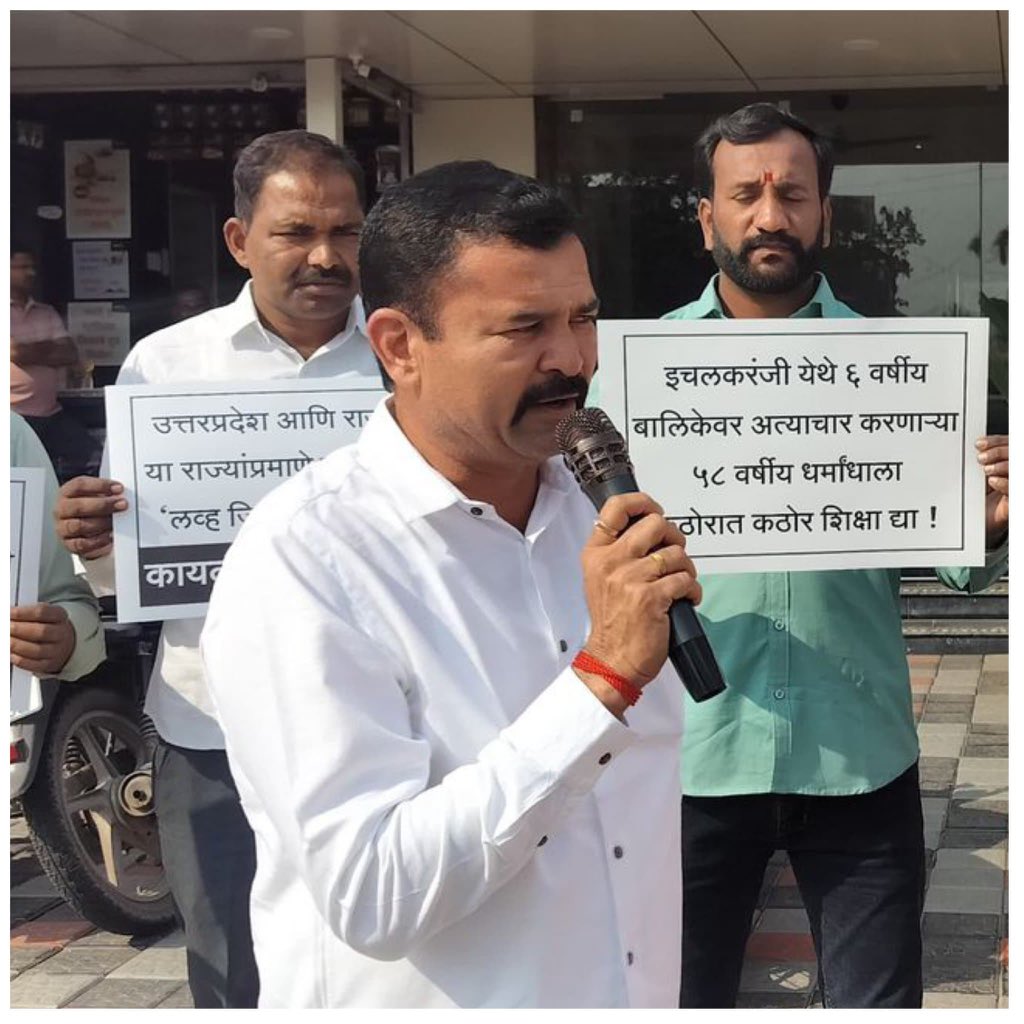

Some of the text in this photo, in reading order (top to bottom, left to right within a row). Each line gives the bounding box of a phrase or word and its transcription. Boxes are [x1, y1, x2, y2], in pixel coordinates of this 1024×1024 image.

[663, 355, 928, 391] इचलकरंजी येथे ६ वर्षीय
[152, 406, 269, 434] उत्तरप्रदेश
[277, 405, 336, 429] आणि
[632, 408, 743, 439] बालिकेवर
[751, 412, 853, 437] अत्याचार
[144, 450, 313, 482] या राज्यांप्रमाणे
[692, 456, 903, 489] ५८ वर्षीय धर्मांधाला
[160, 505, 221, 531] ‘लव्ह
[666, 505, 937, 538] ठोरात कठोर शिक्षा द्या !
